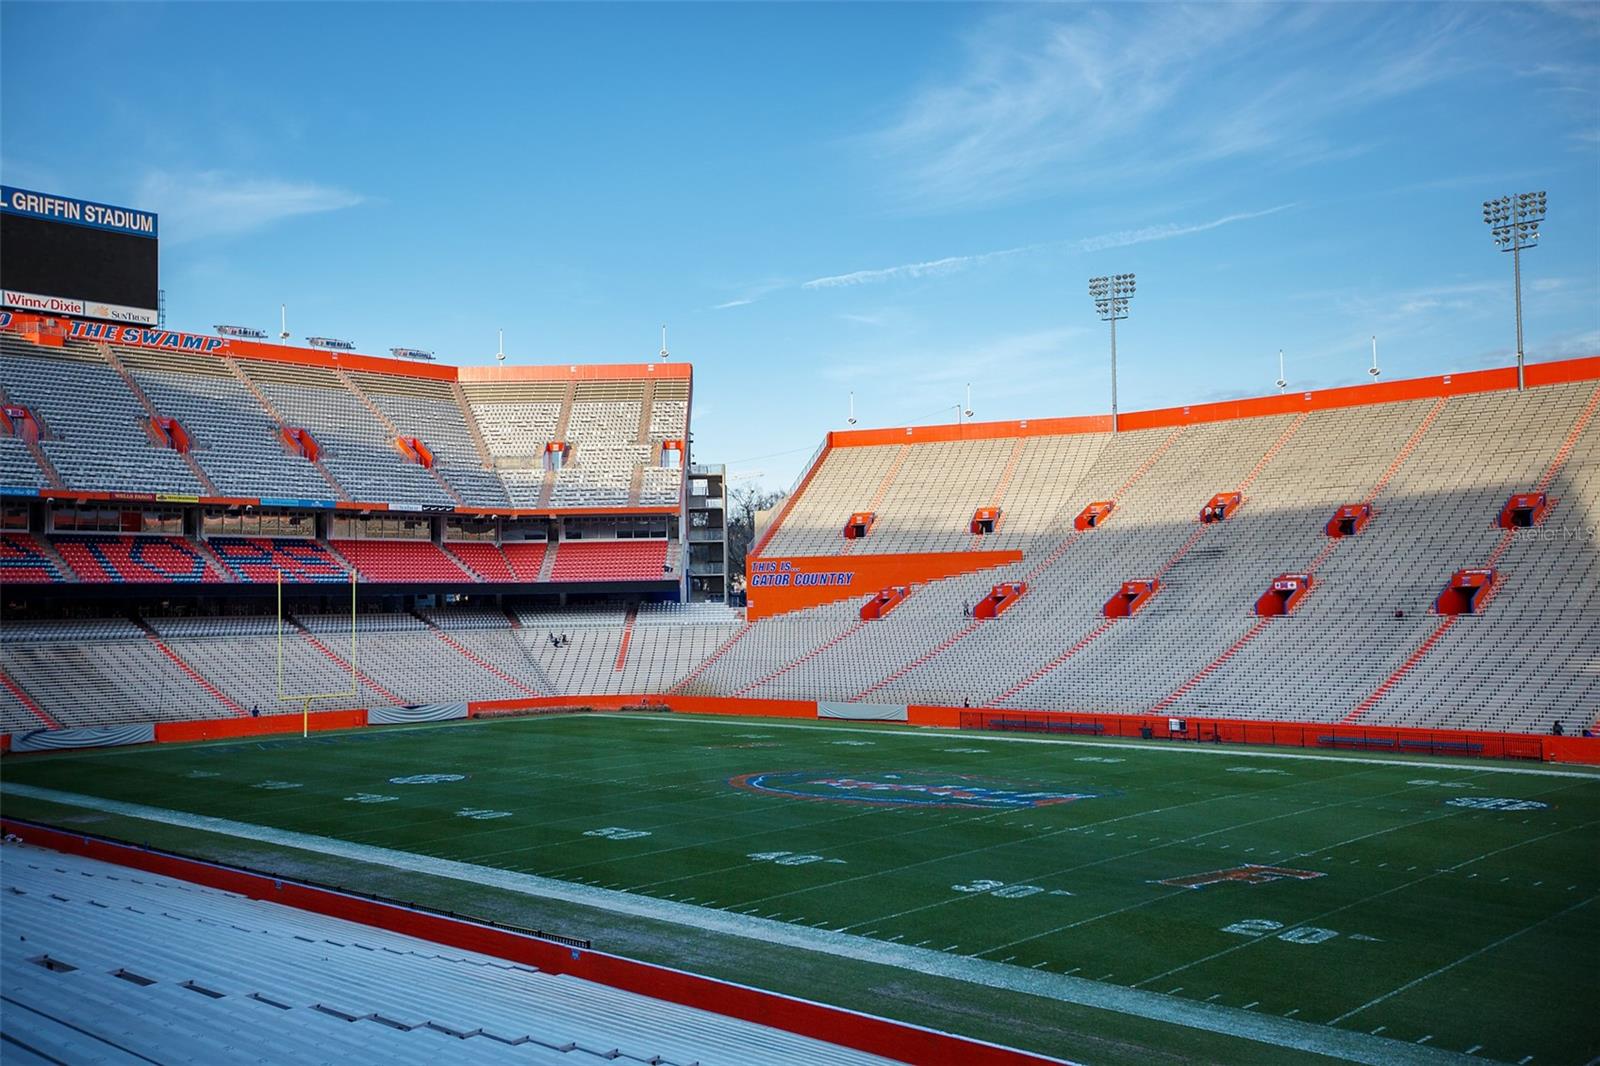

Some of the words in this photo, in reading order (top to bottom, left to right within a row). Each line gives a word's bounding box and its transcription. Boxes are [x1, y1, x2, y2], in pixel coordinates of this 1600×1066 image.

[12, 192, 80, 220] GRIFFIN
[84, 205, 153, 232] STADIUM
[69, 321, 120, 340] THE
[122, 327, 225, 352] SWAMP
[751, 561, 779, 572] THIS
[751, 573, 790, 587] GATOR
[795, 572, 855, 586] COUNTRY
